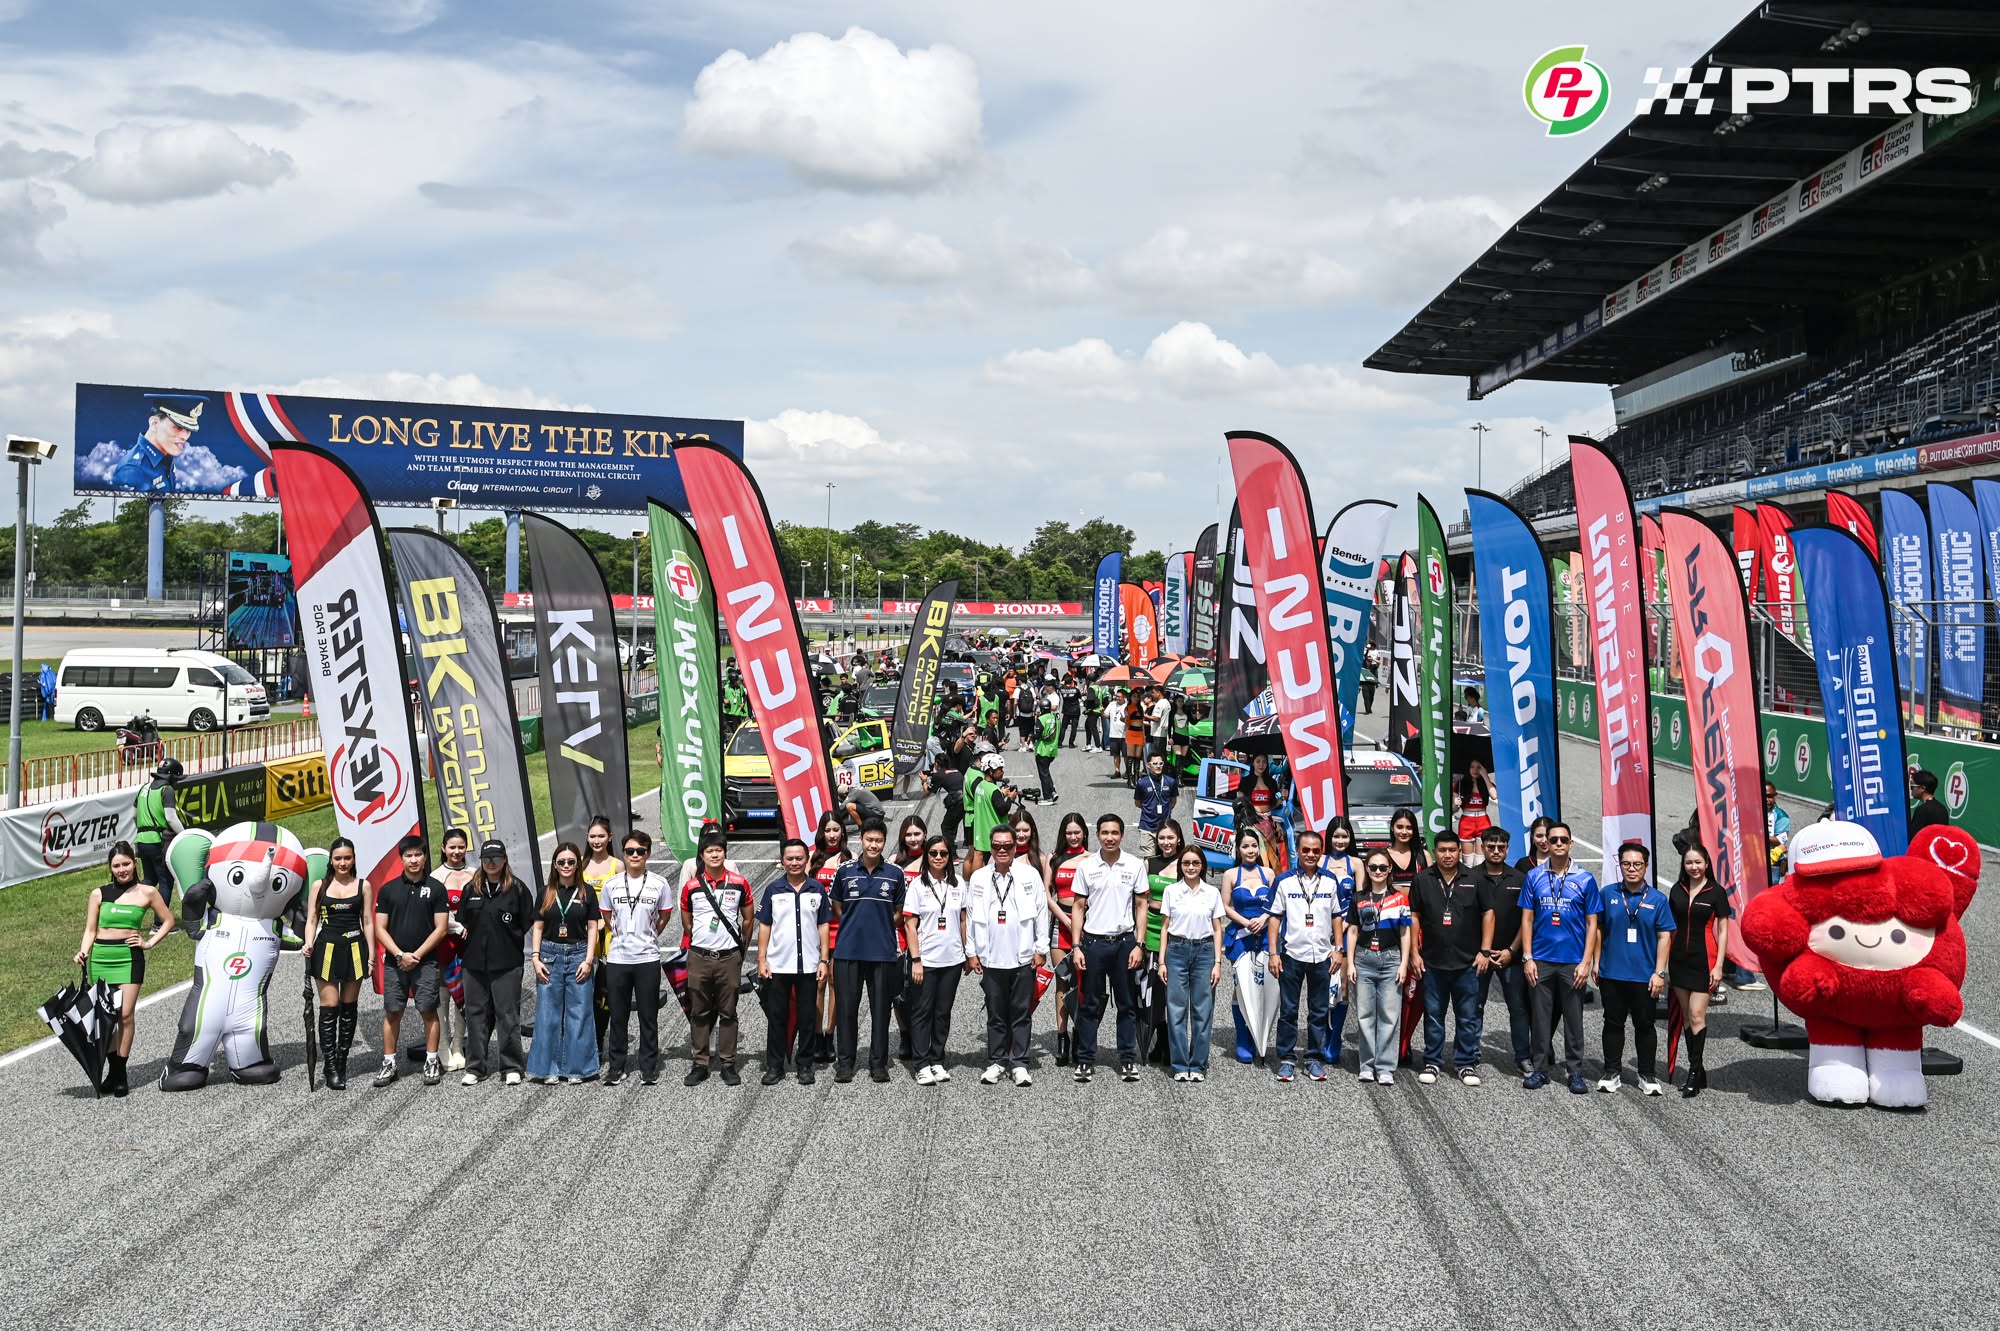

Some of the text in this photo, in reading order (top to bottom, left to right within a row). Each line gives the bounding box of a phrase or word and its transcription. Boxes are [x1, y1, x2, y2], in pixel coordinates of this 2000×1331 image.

[1886, 120, 1914, 142] TOYOTA
[1884, 133, 1911, 153] GAZOO
[1884, 145, 1909, 164] Racing
[1820, 173, 1843, 190] GAZOO
[1820, 184, 1843, 200] Racing
[328, 414, 710, 459] LONG LIVE THE KIN
[1929, 450, 1941, 462] PUT
[1941, 448, 1954, 460] OUR
[1977, 441, 1992, 454] INTO
[414, 454, 635, 471] WITH THE UTMOST RESPECT FROM THE MANAGEMENT
[406, 463, 426, 471] AND
[427, 464, 451, 472] TEAM
[495, 466, 506, 475] OF
[508, 467, 539, 476] CHANG
[540, 469, 606, 479] INTERNATIONAL
[607, 471, 642, 481] CIRCUIT
[447, 480, 573, 494] Chang INTERNATIONAL CIRCUIT
[1331, 546, 1368, 564] Bendix
[1326, 576, 1369, 593] Brakes
[894, 602, 970, 614] HOA
[992, 603, 1064, 615] HONDA
[1098, 578, 1111, 649] VOLTRONIC
[1166, 577, 1180, 638] RYNNI
[1196, 579, 1214, 651] WISE
[918, 600, 949, 657] BK
[906, 657, 926, 725] CLUTCH
[917, 658, 938, 726] RACING
[839, 771, 853, 786] 63
[859, 761, 895, 783] BK
[240, 782, 254, 792] PART
[277, 766, 325, 803] Giti
[860, 780, 895, 788] MOTORS
[1950, 777, 1964, 806] PT
[235, 797, 249, 808] YOUR
[44, 812, 120, 853] NEXZTER
[1802, 844, 1831, 856] TRUSTED
[229, 957, 247, 975] PT
